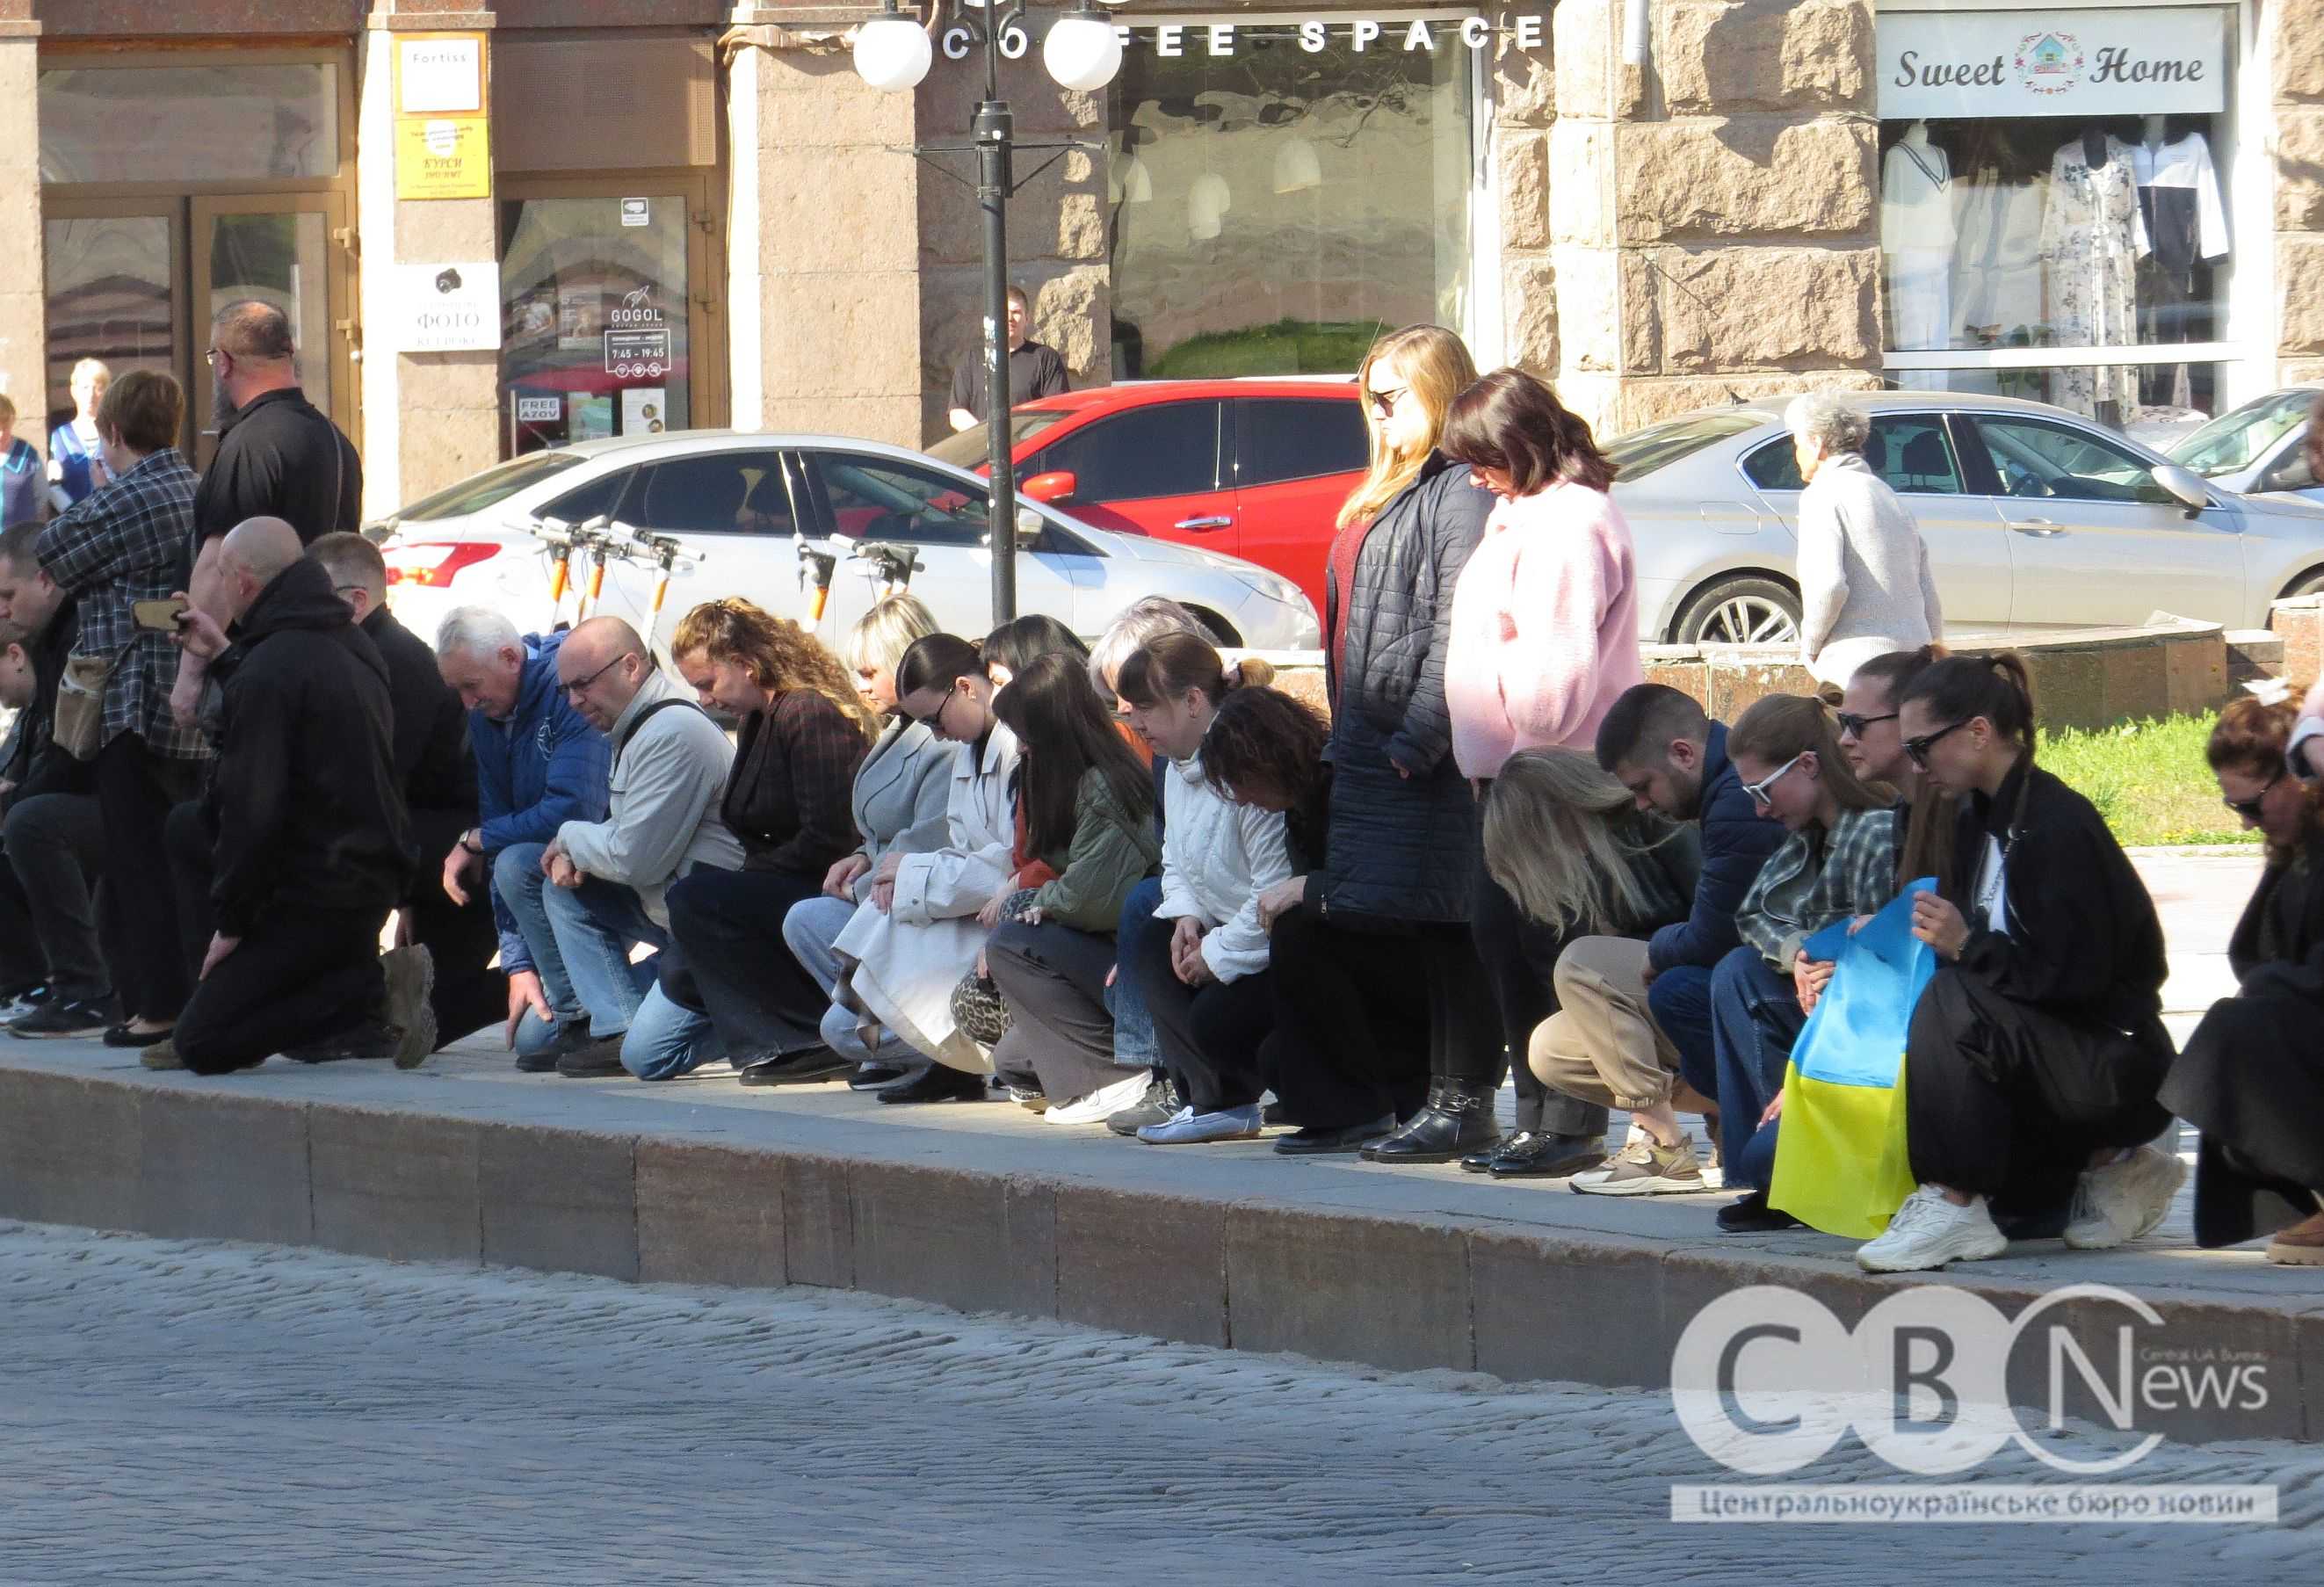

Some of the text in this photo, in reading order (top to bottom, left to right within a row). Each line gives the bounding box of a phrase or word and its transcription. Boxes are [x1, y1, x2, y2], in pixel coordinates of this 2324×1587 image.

[943, 16, 1542, 59] COEE SPACE
[413, 54, 466, 63] Fortiss
[1894, 47, 2204, 87] Sweet Home
[417, 313, 480, 329] ФОТО
[612, 308, 662, 322] GOGOL
[522, 399, 557, 409] FREE
